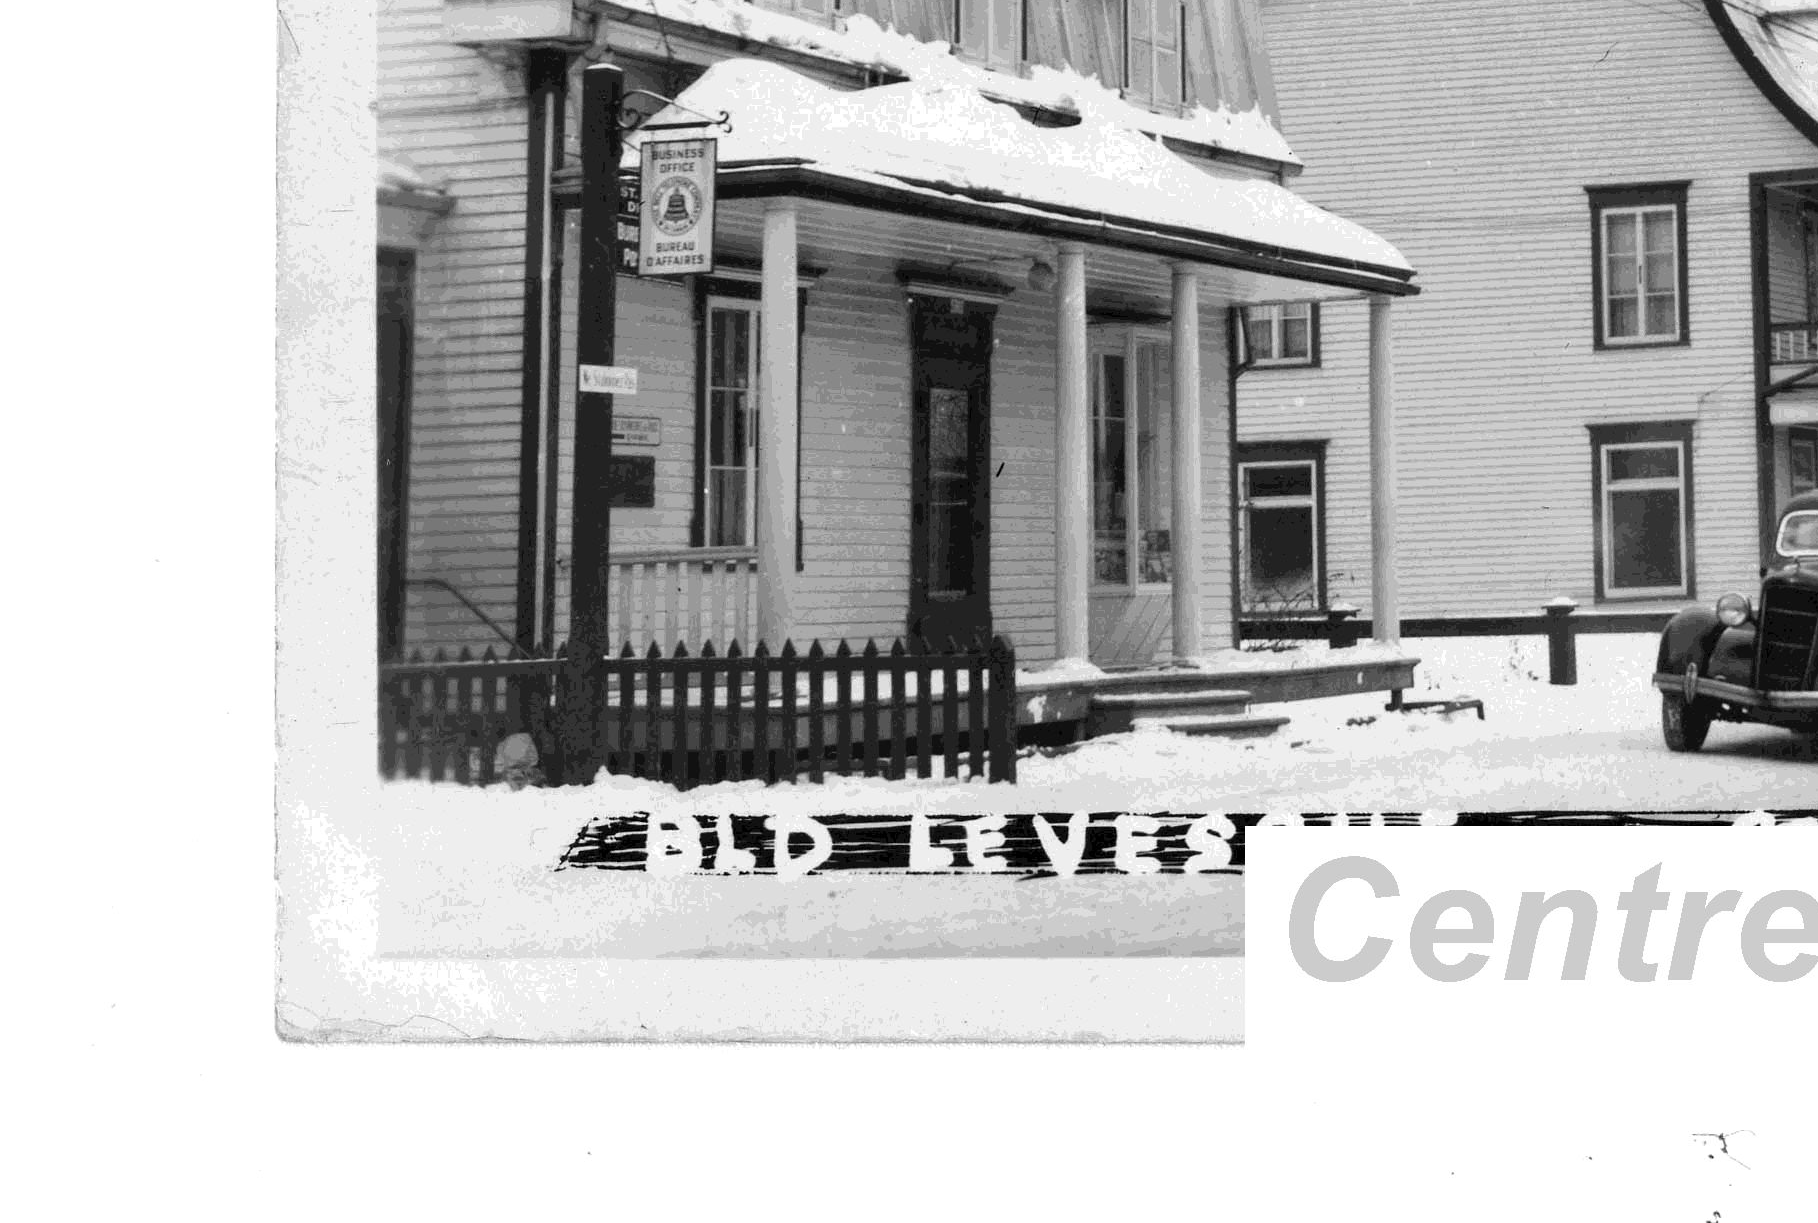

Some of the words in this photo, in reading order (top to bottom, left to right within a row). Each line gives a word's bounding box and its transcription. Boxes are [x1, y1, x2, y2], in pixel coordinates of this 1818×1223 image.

[651, 148, 705, 160] BUSINESS
[659, 162, 695, 173] OFFICE
[656, 241, 695, 253] BUREAU
